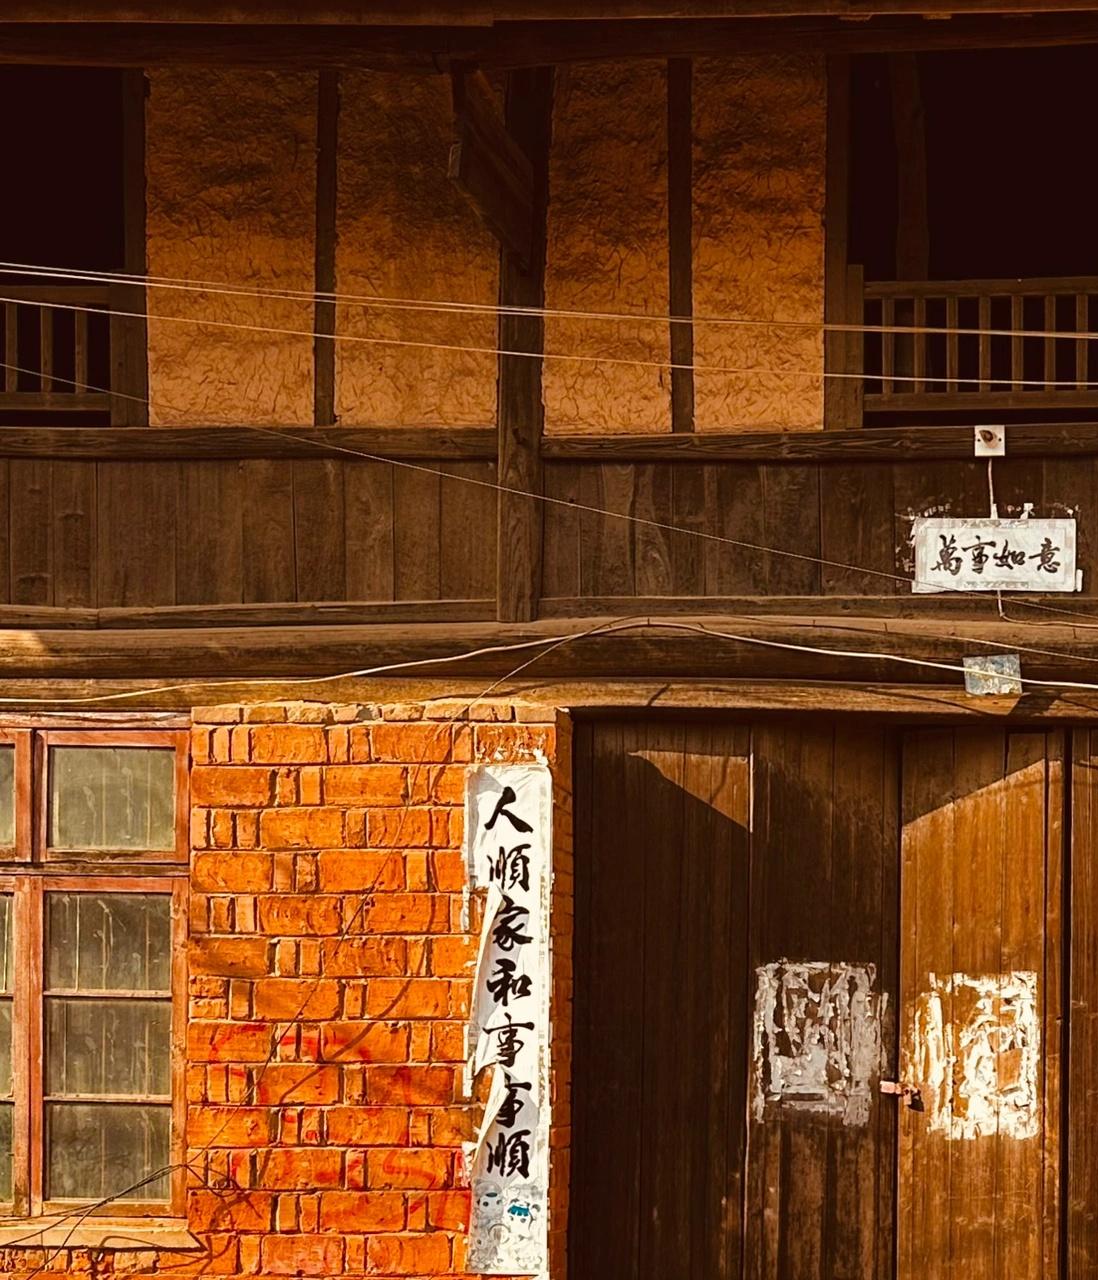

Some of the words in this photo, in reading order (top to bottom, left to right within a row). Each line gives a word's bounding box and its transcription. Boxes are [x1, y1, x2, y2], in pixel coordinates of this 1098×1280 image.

[930, 534, 1061, 576] 萬事如意
[483, 786, 535, 1179] 人順家和事事順
